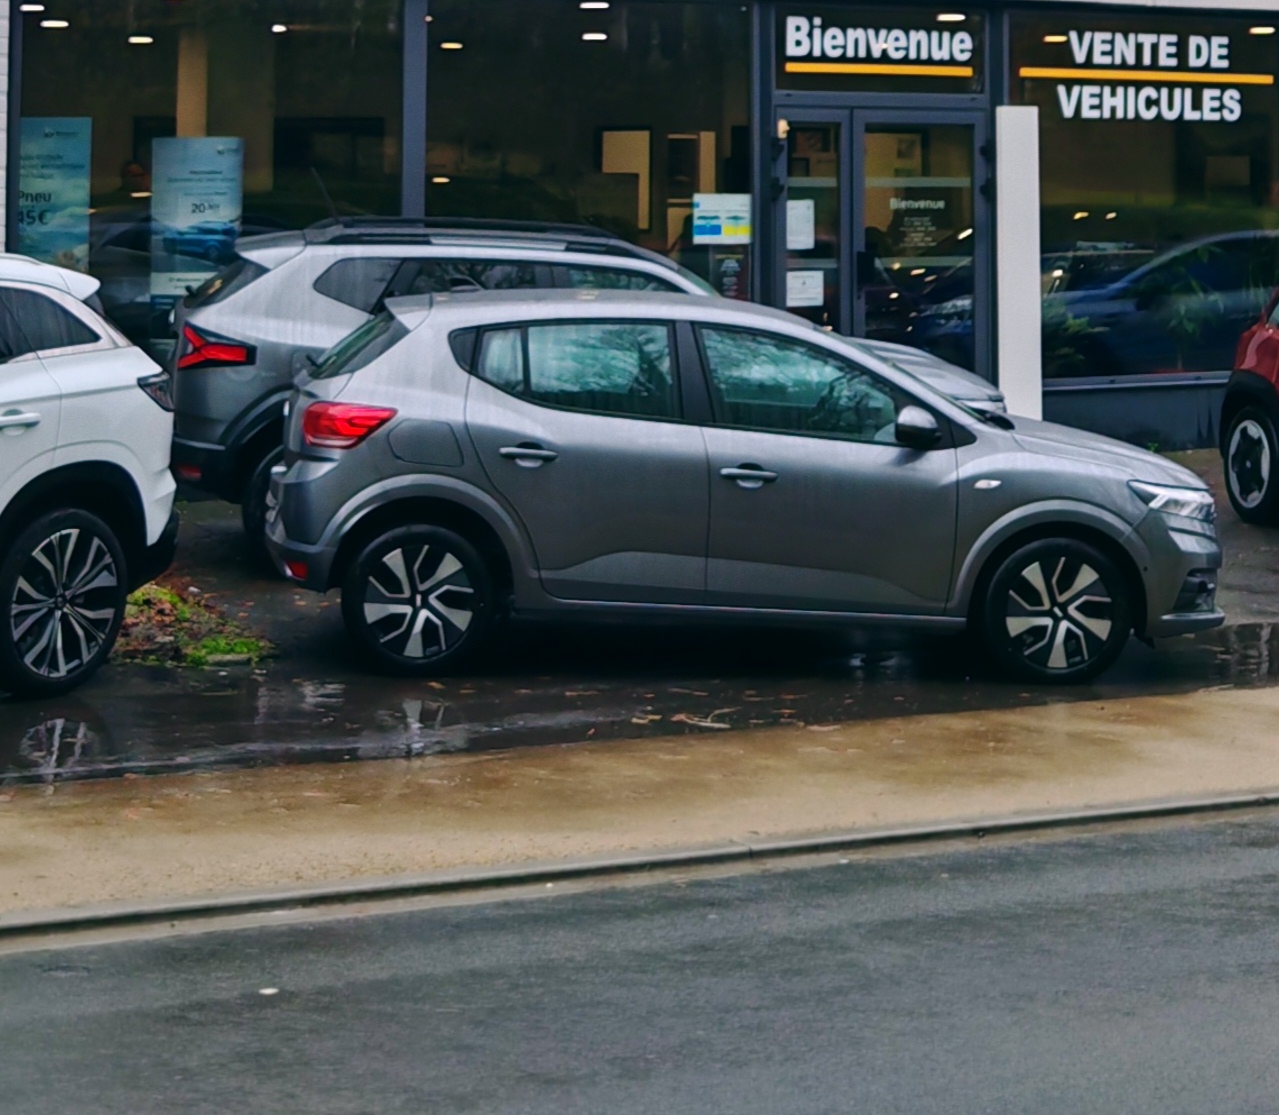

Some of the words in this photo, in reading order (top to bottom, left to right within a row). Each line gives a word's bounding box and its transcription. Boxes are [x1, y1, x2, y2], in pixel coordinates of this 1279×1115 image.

[785, 15, 973, 62] Bienvenue
[1068, 30, 1178, 67] VENTE
[1188, 34, 1230, 69] DE
[1057, 84, 1242, 123] VEHICULES
[890, 197, 945, 209] Bienvenue
